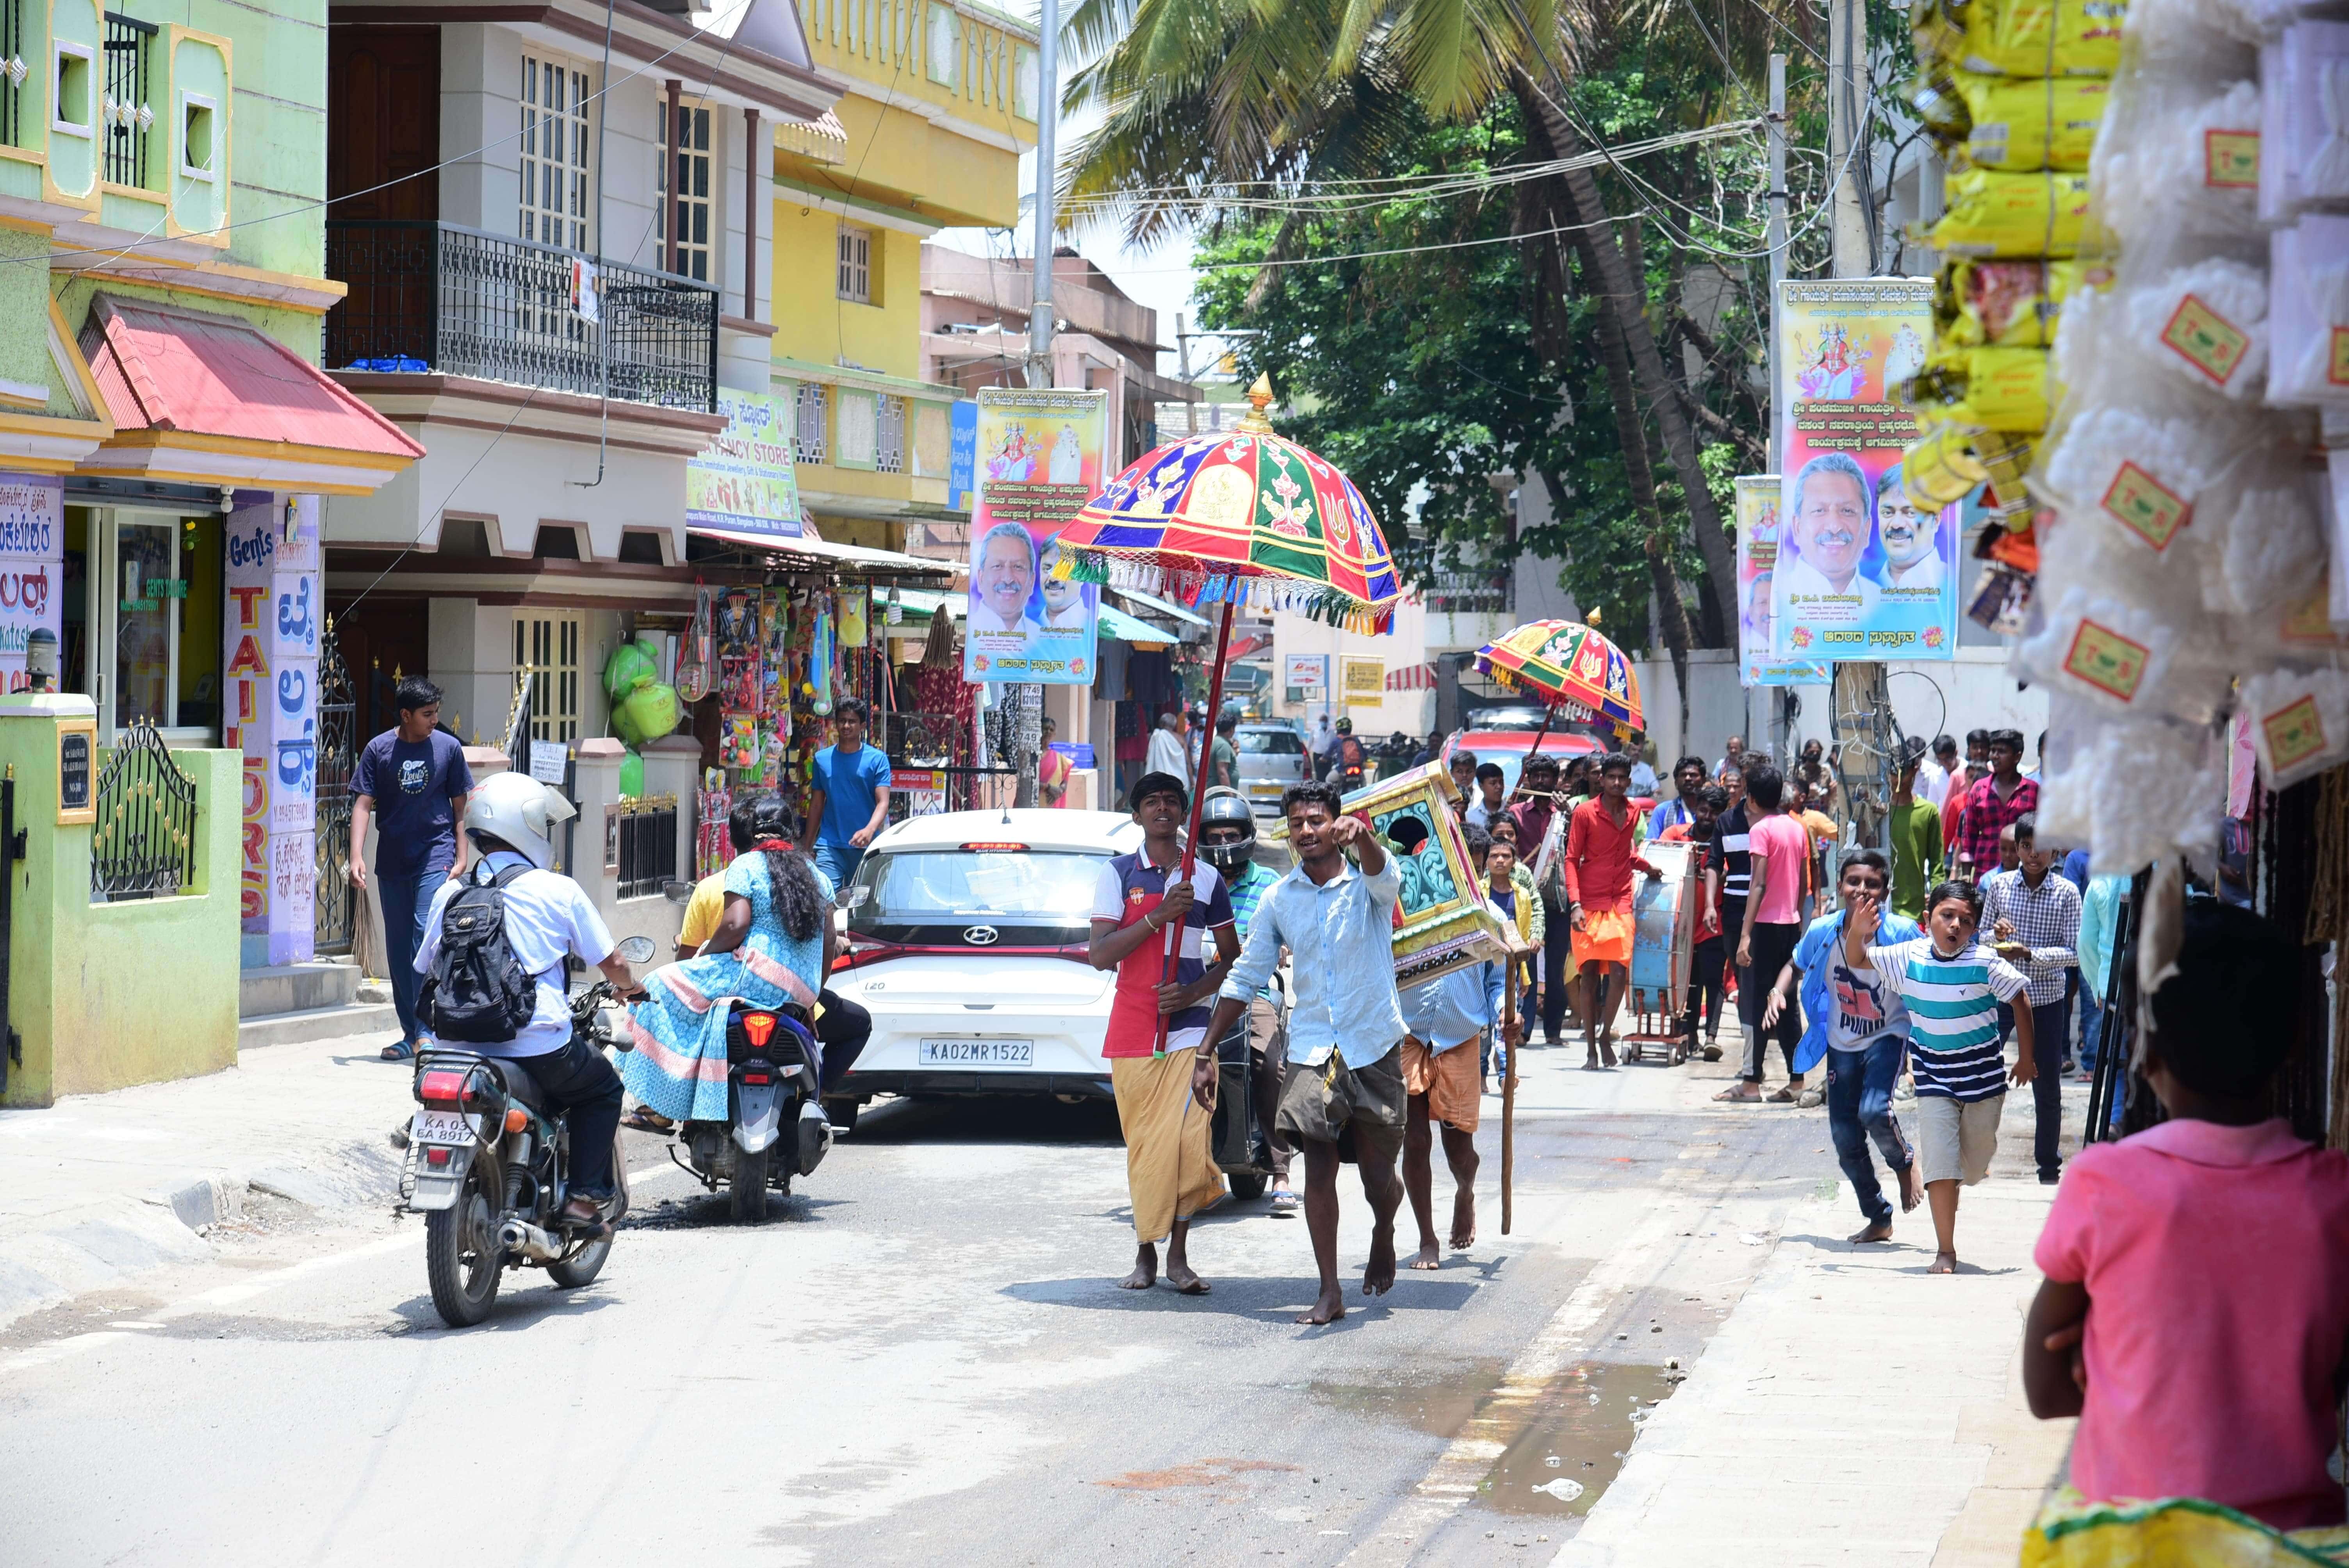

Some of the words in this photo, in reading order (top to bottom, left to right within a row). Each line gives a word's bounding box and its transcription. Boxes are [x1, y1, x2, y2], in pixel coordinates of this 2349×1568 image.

[1793, 402, 1805, 416] ಶ್ರೀ
[1797, 419, 1825, 430] ವಸಂತ
[754, 443, 790, 466] STORE
[954, 469, 970, 490] Bank
[982, 482, 991, 493] ಶ್ರೀ
[985, 496, 1005, 505] ವಸಂತ
[0, 513, 51, 556] ಂಕಟೇಶ್ವರ
[230, 526, 272, 567] Gents
[0, 565, 48, 616] ಲರ್ಸ್
[146, 578, 164, 598] GENTS
[930, 1043, 1030, 1060] KA02MR1522
[425, 1118, 445, 1130] KA
[450, 1119, 467, 1130] 03
[417, 1128, 434, 1139] EA
[439, 1130, 472, 1142] 8917
